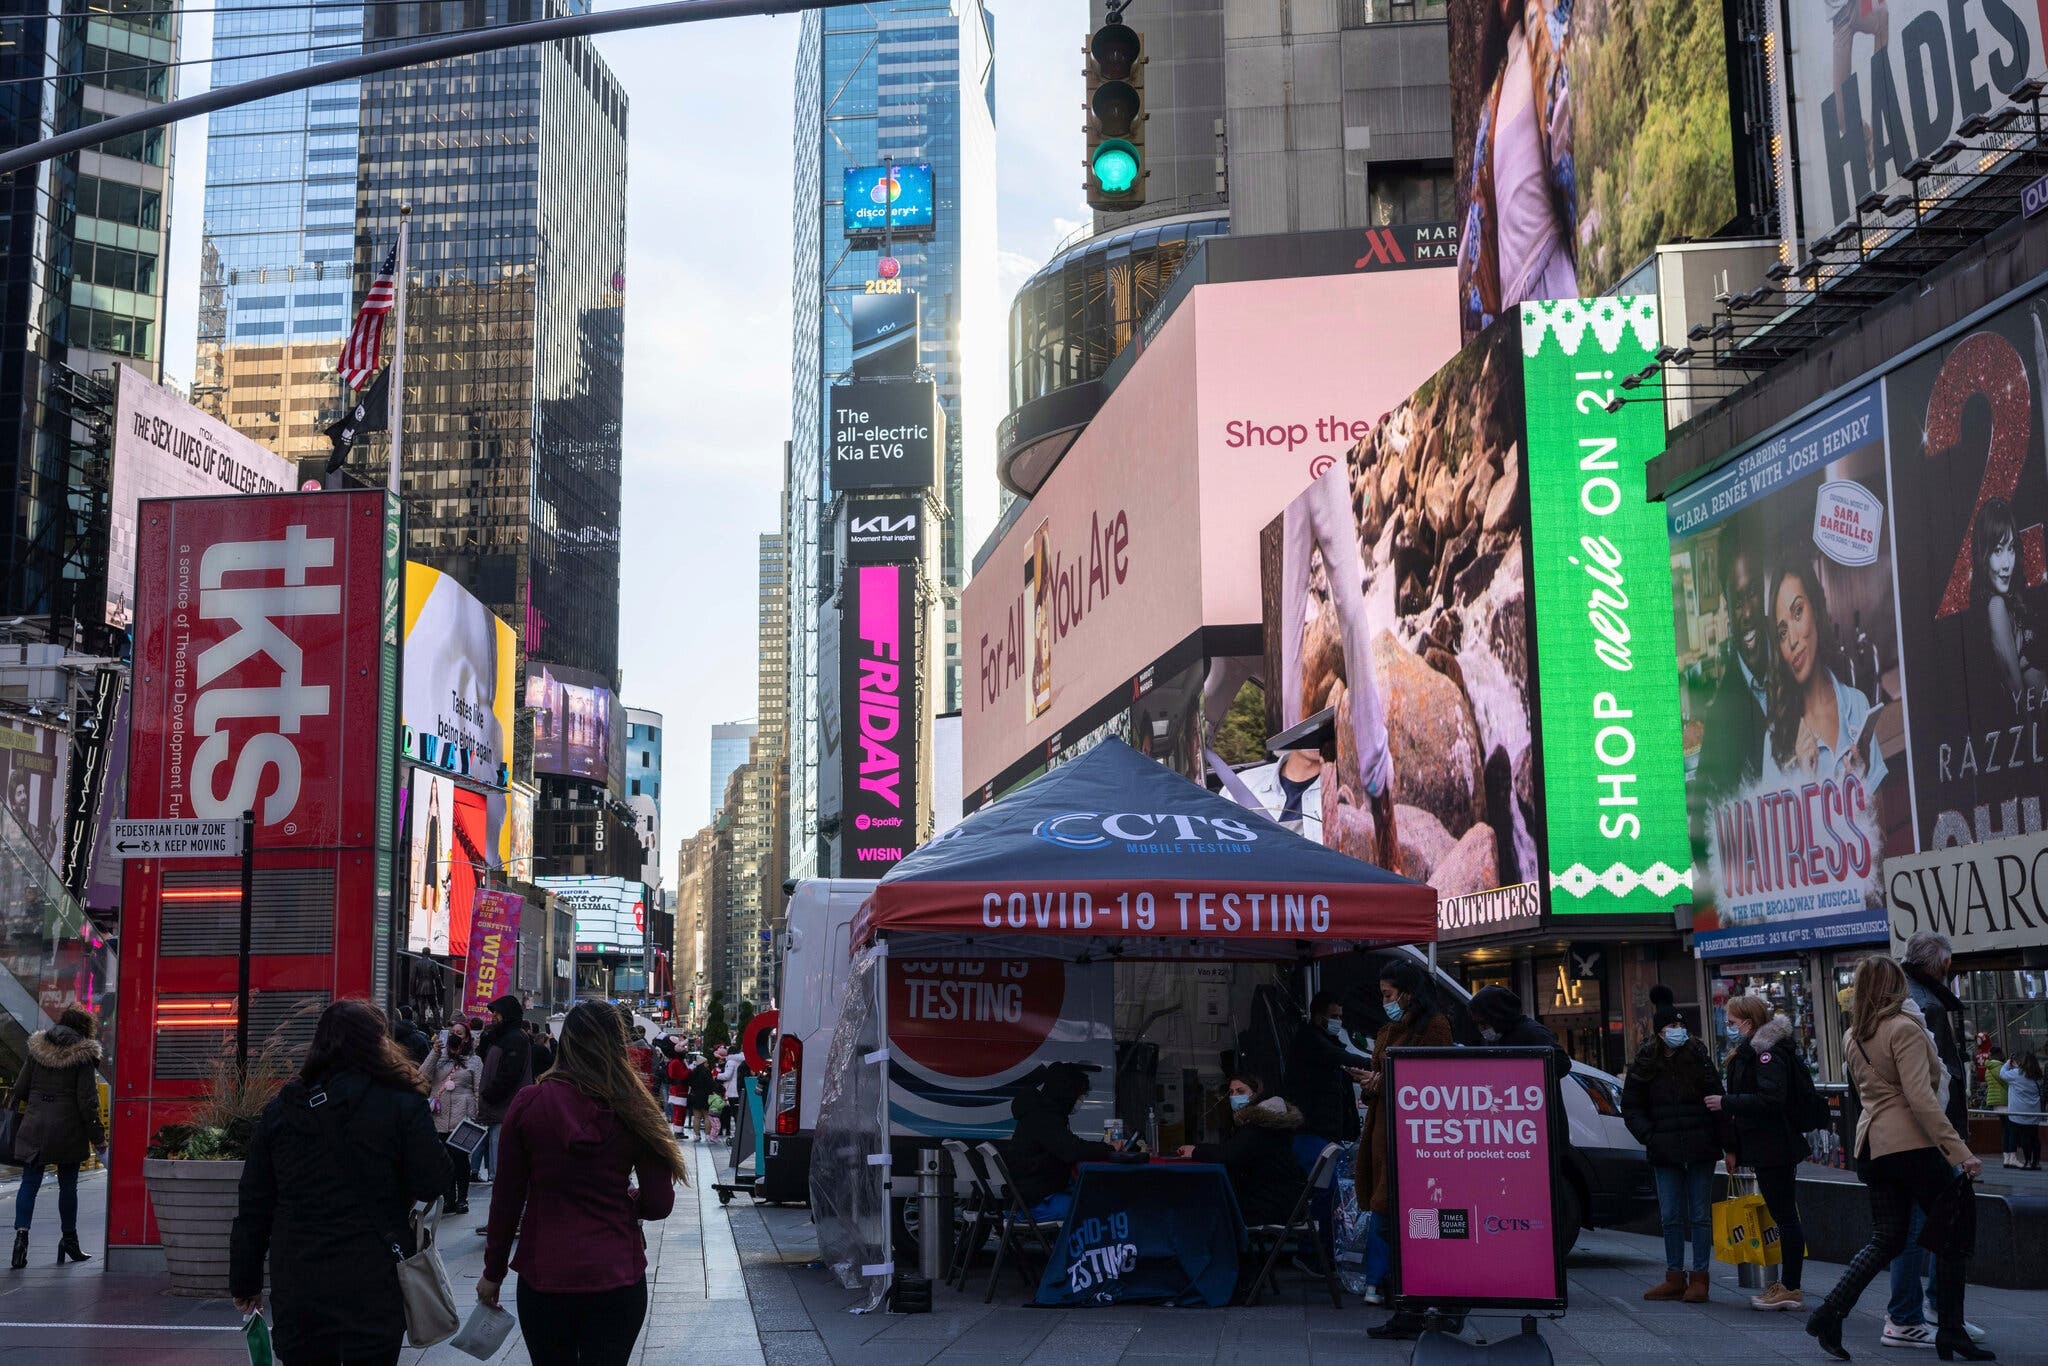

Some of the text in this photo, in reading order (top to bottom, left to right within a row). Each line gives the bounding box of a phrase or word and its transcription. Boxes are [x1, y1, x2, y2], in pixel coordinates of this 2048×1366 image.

[856, 206, 918, 218] discoery+
[1418, 244, 1458, 258] MAR
[864, 278, 902, 295] 2021
[837, 409, 869, 424] The
[837, 425, 928, 442] all-electric
[1226, 420, 1308, 452] Shop
[1315, 415, 1370, 442] the
[134, 412, 150, 441] THE
[151, 416, 173, 453] SEX
[173, 428, 201, 468] LIVES
[203, 445, 217, 475] OF
[218, 453, 258, 494] COLLEGE
[837, 444, 904, 461] Kia EV6
[1738, 438, 1787, 477] STARRING
[1580, 437, 1622, 517] ON
[1674, 414, 1871, 534] CIARA RENÉE WITH JOSH HENRY
[851, 515, 916, 533] KIA
[1820, 515, 1873, 544] BAREILLES
[1833, 505, 1860, 525] SARA
[981, 509, 1129, 713] For All You Are
[1568, 534, 1634, 672] aerie
[169, 545, 190, 819] a service of Theatre Development Fun
[190, 524, 341, 827] tkts
[452, 690, 485, 730] Tastes like
[860, 637, 900, 808] FRIDAY
[437, 714, 459, 752] being
[476, 741, 493, 766] again
[1593, 691, 1641, 840] SHOP
[115, 823, 226, 837] PEDESTRIAN FLOW ZONE
[595, 810, 604, 851] 1500
[872, 817, 903, 829] Spotify
[1713, 774, 1871, 899] WAITRESS
[164, 839, 226, 852] KEEP MOVING
[857, 848, 902, 861] WISIN
[1126, 842, 1252, 854] MOBILE TESTING
[569, 902, 612, 911] RISTMAS
[982, 892, 1330, 933] COVID-19 TESTING
[1446, 882, 1539, 929] OUTFITTERS
[1733, 888, 1861, 920] THE HIT BROADWAY MUSICAL
[1704, 937, 1739, 952] BARRYMORE
[1740, 933, 1765, 948] THEATRE
[1769, 932, 1780, 943] 243
[476, 934, 501, 999] WISH
[904, 978, 1023, 1024] TESTING
[1397, 1085, 1544, 1111] COVID-19
[1405, 1119, 1538, 1145] TESTING
[1416, 1149, 1531, 1160] No out of pocket cost
